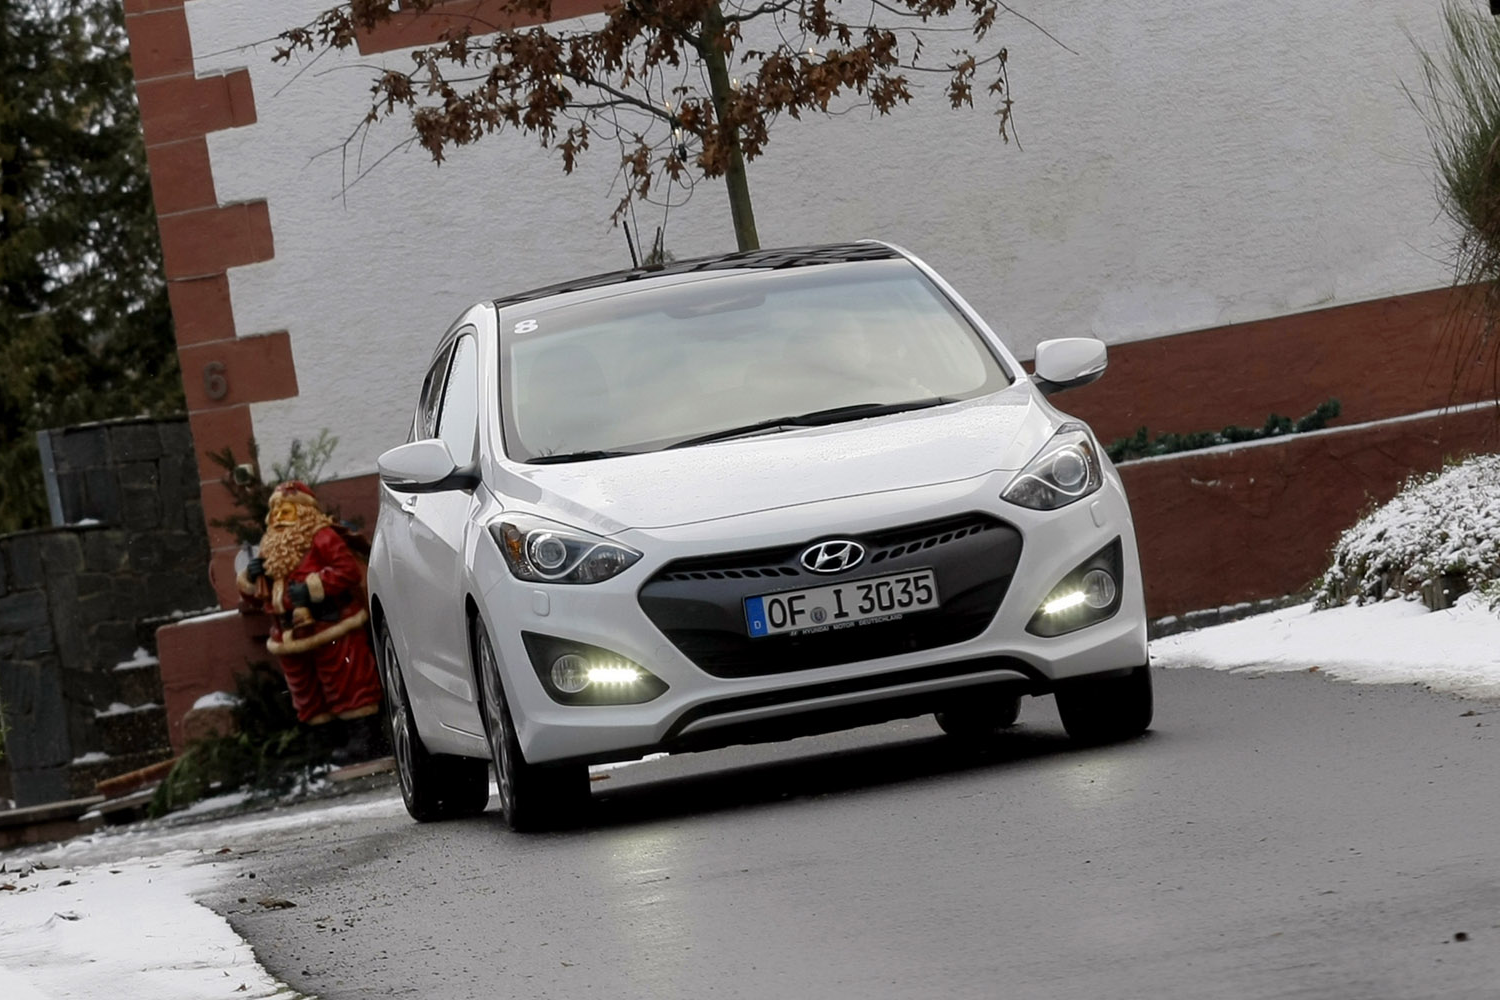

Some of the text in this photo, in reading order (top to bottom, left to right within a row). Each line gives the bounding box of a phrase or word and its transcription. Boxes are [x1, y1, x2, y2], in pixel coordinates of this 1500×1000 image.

[514, 319, 539, 334] 8
[203, 360, 228, 401] 6
[768, 574, 933, 628] OF I 3035
[753, 621, 762, 630] D
[802, 614, 903, 635] HYUNDAI MOTOR DEUTSCHLAND
